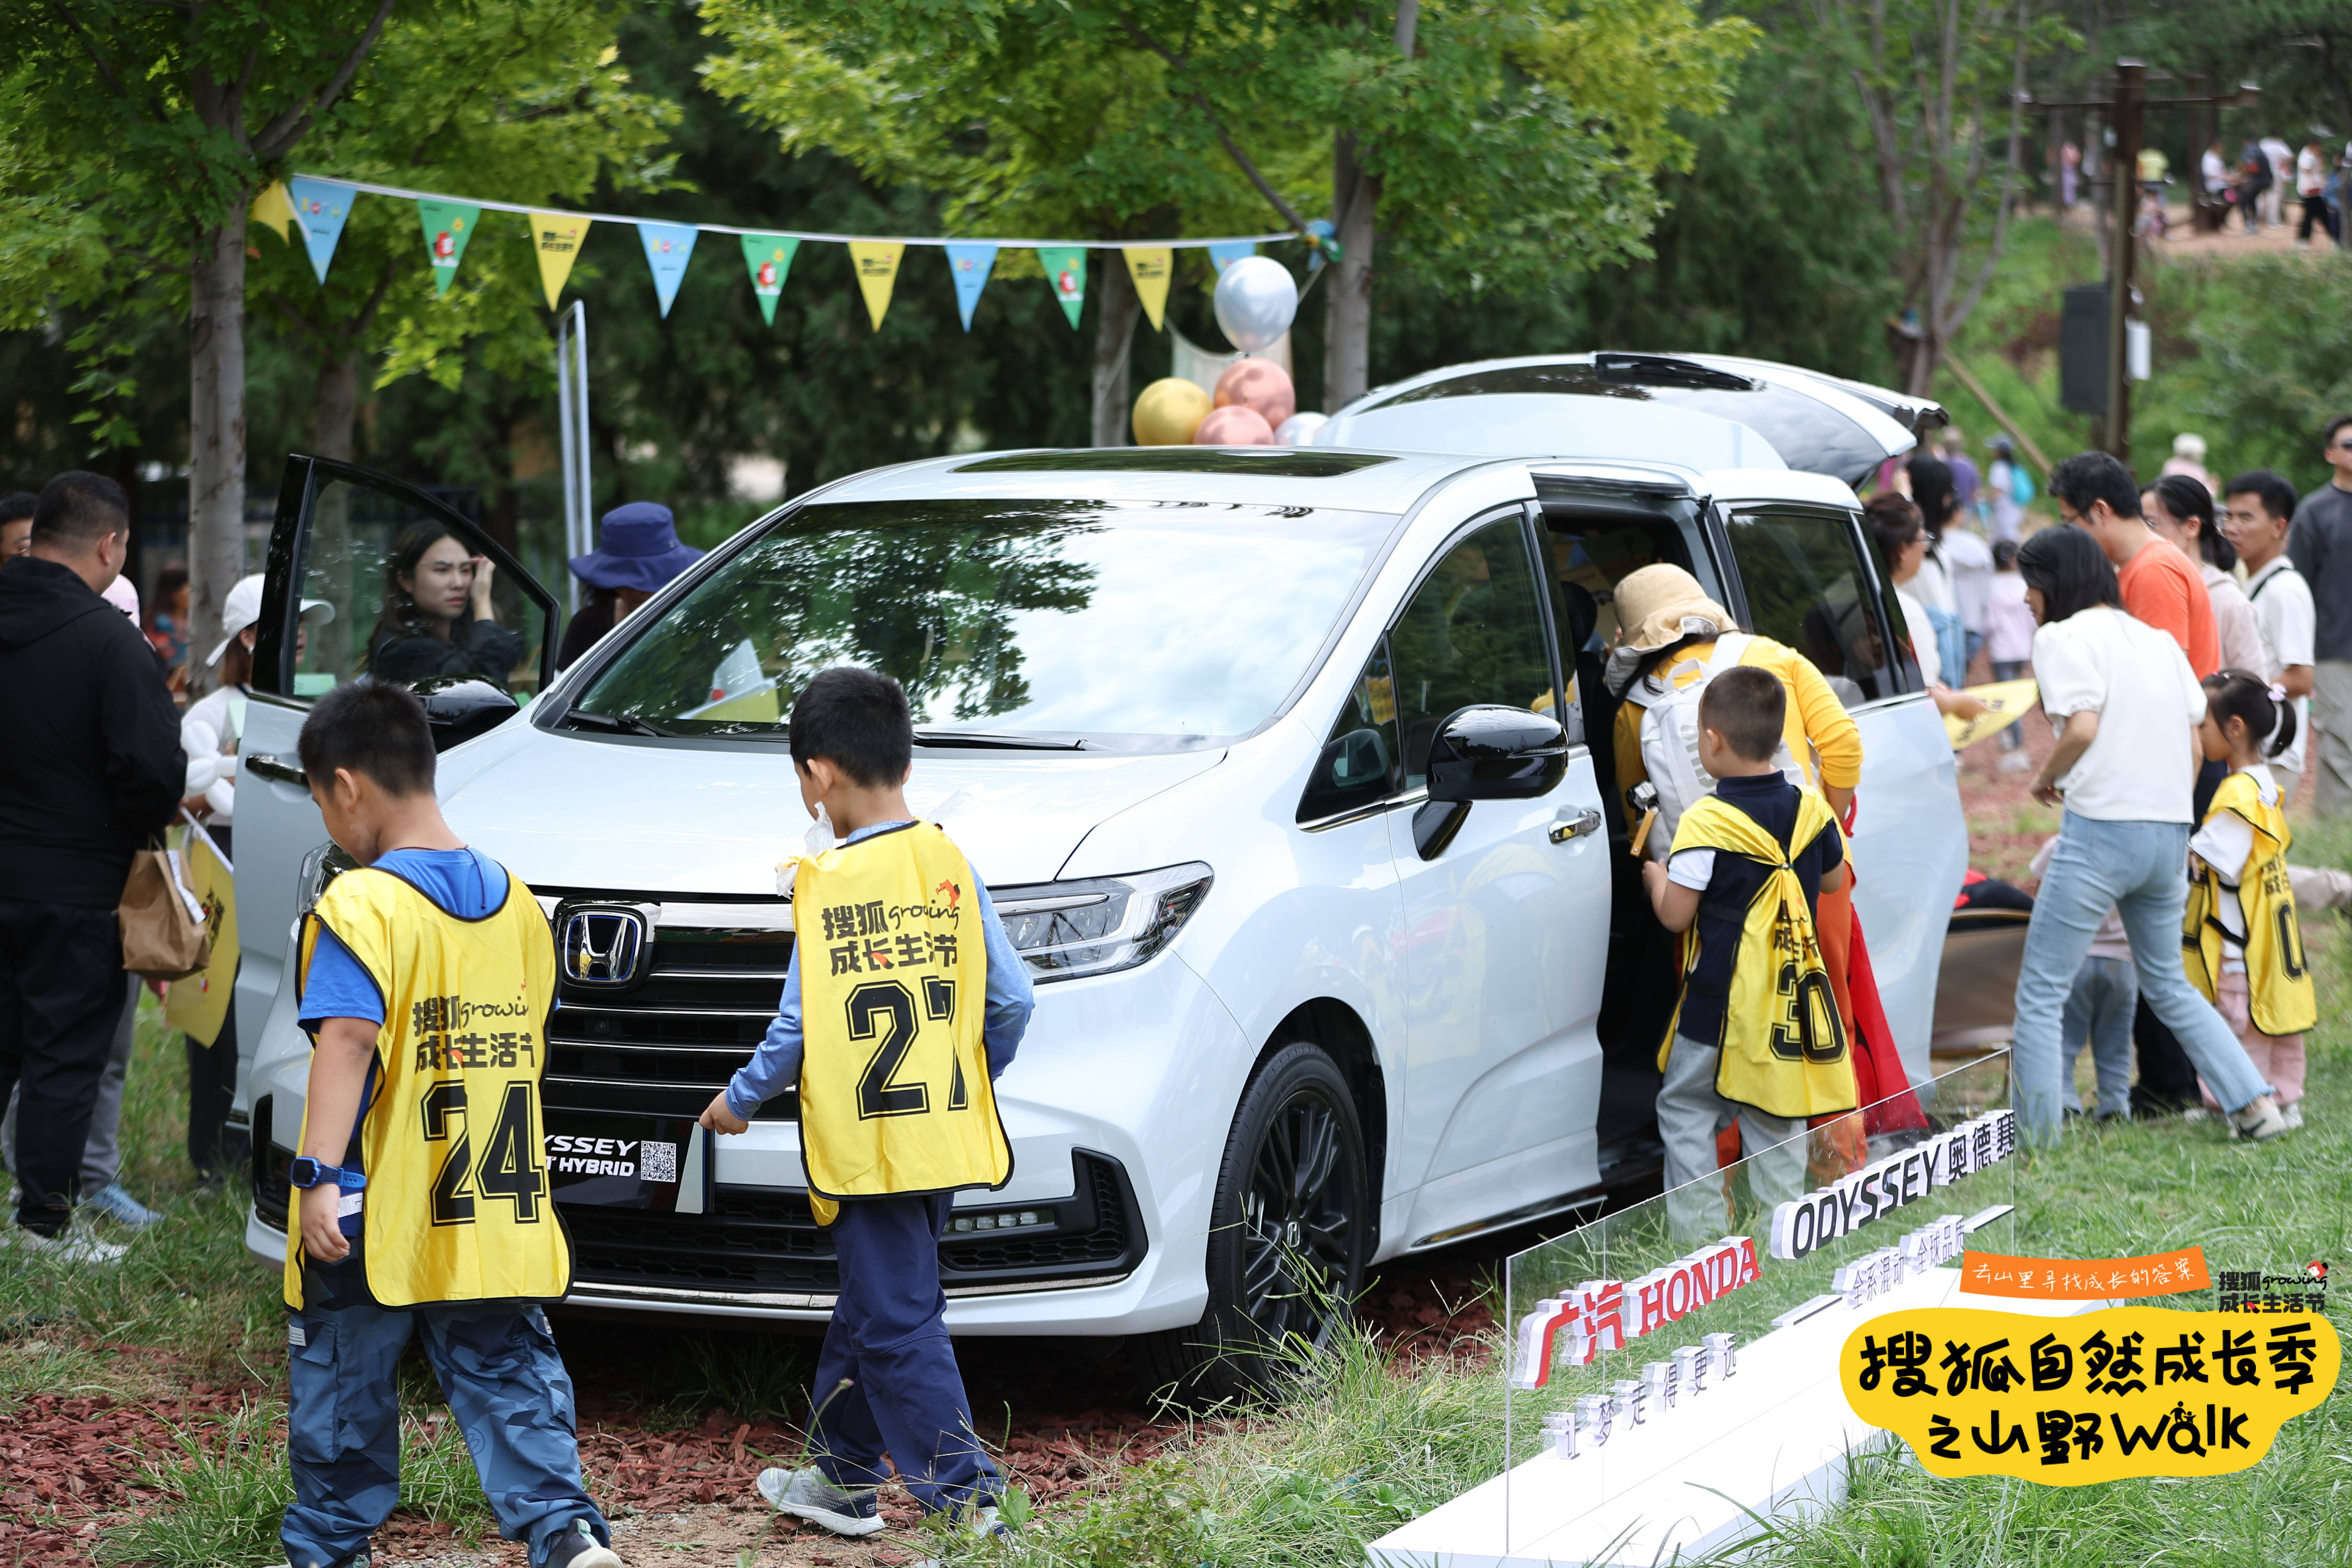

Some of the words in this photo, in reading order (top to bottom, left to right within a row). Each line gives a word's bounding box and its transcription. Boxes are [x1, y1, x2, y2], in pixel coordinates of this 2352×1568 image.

[822, 900, 889, 941] 搜狐
[845, 975, 968, 1122] 27
[1769, 960, 1848, 1065] 30
[421, 1079, 547, 1227] 24
[559, 1157, 635, 1177] HYBRID
[1791, 1143, 1942, 1260] ODYSSEY
[1948, 1110, 2015, 1185] 奥德赛
[1531, 1281, 1626, 1390] 广汽
[1638, 1237, 1761, 1337] HONDA
[1852, 1250, 1905, 1310] 全系混动
